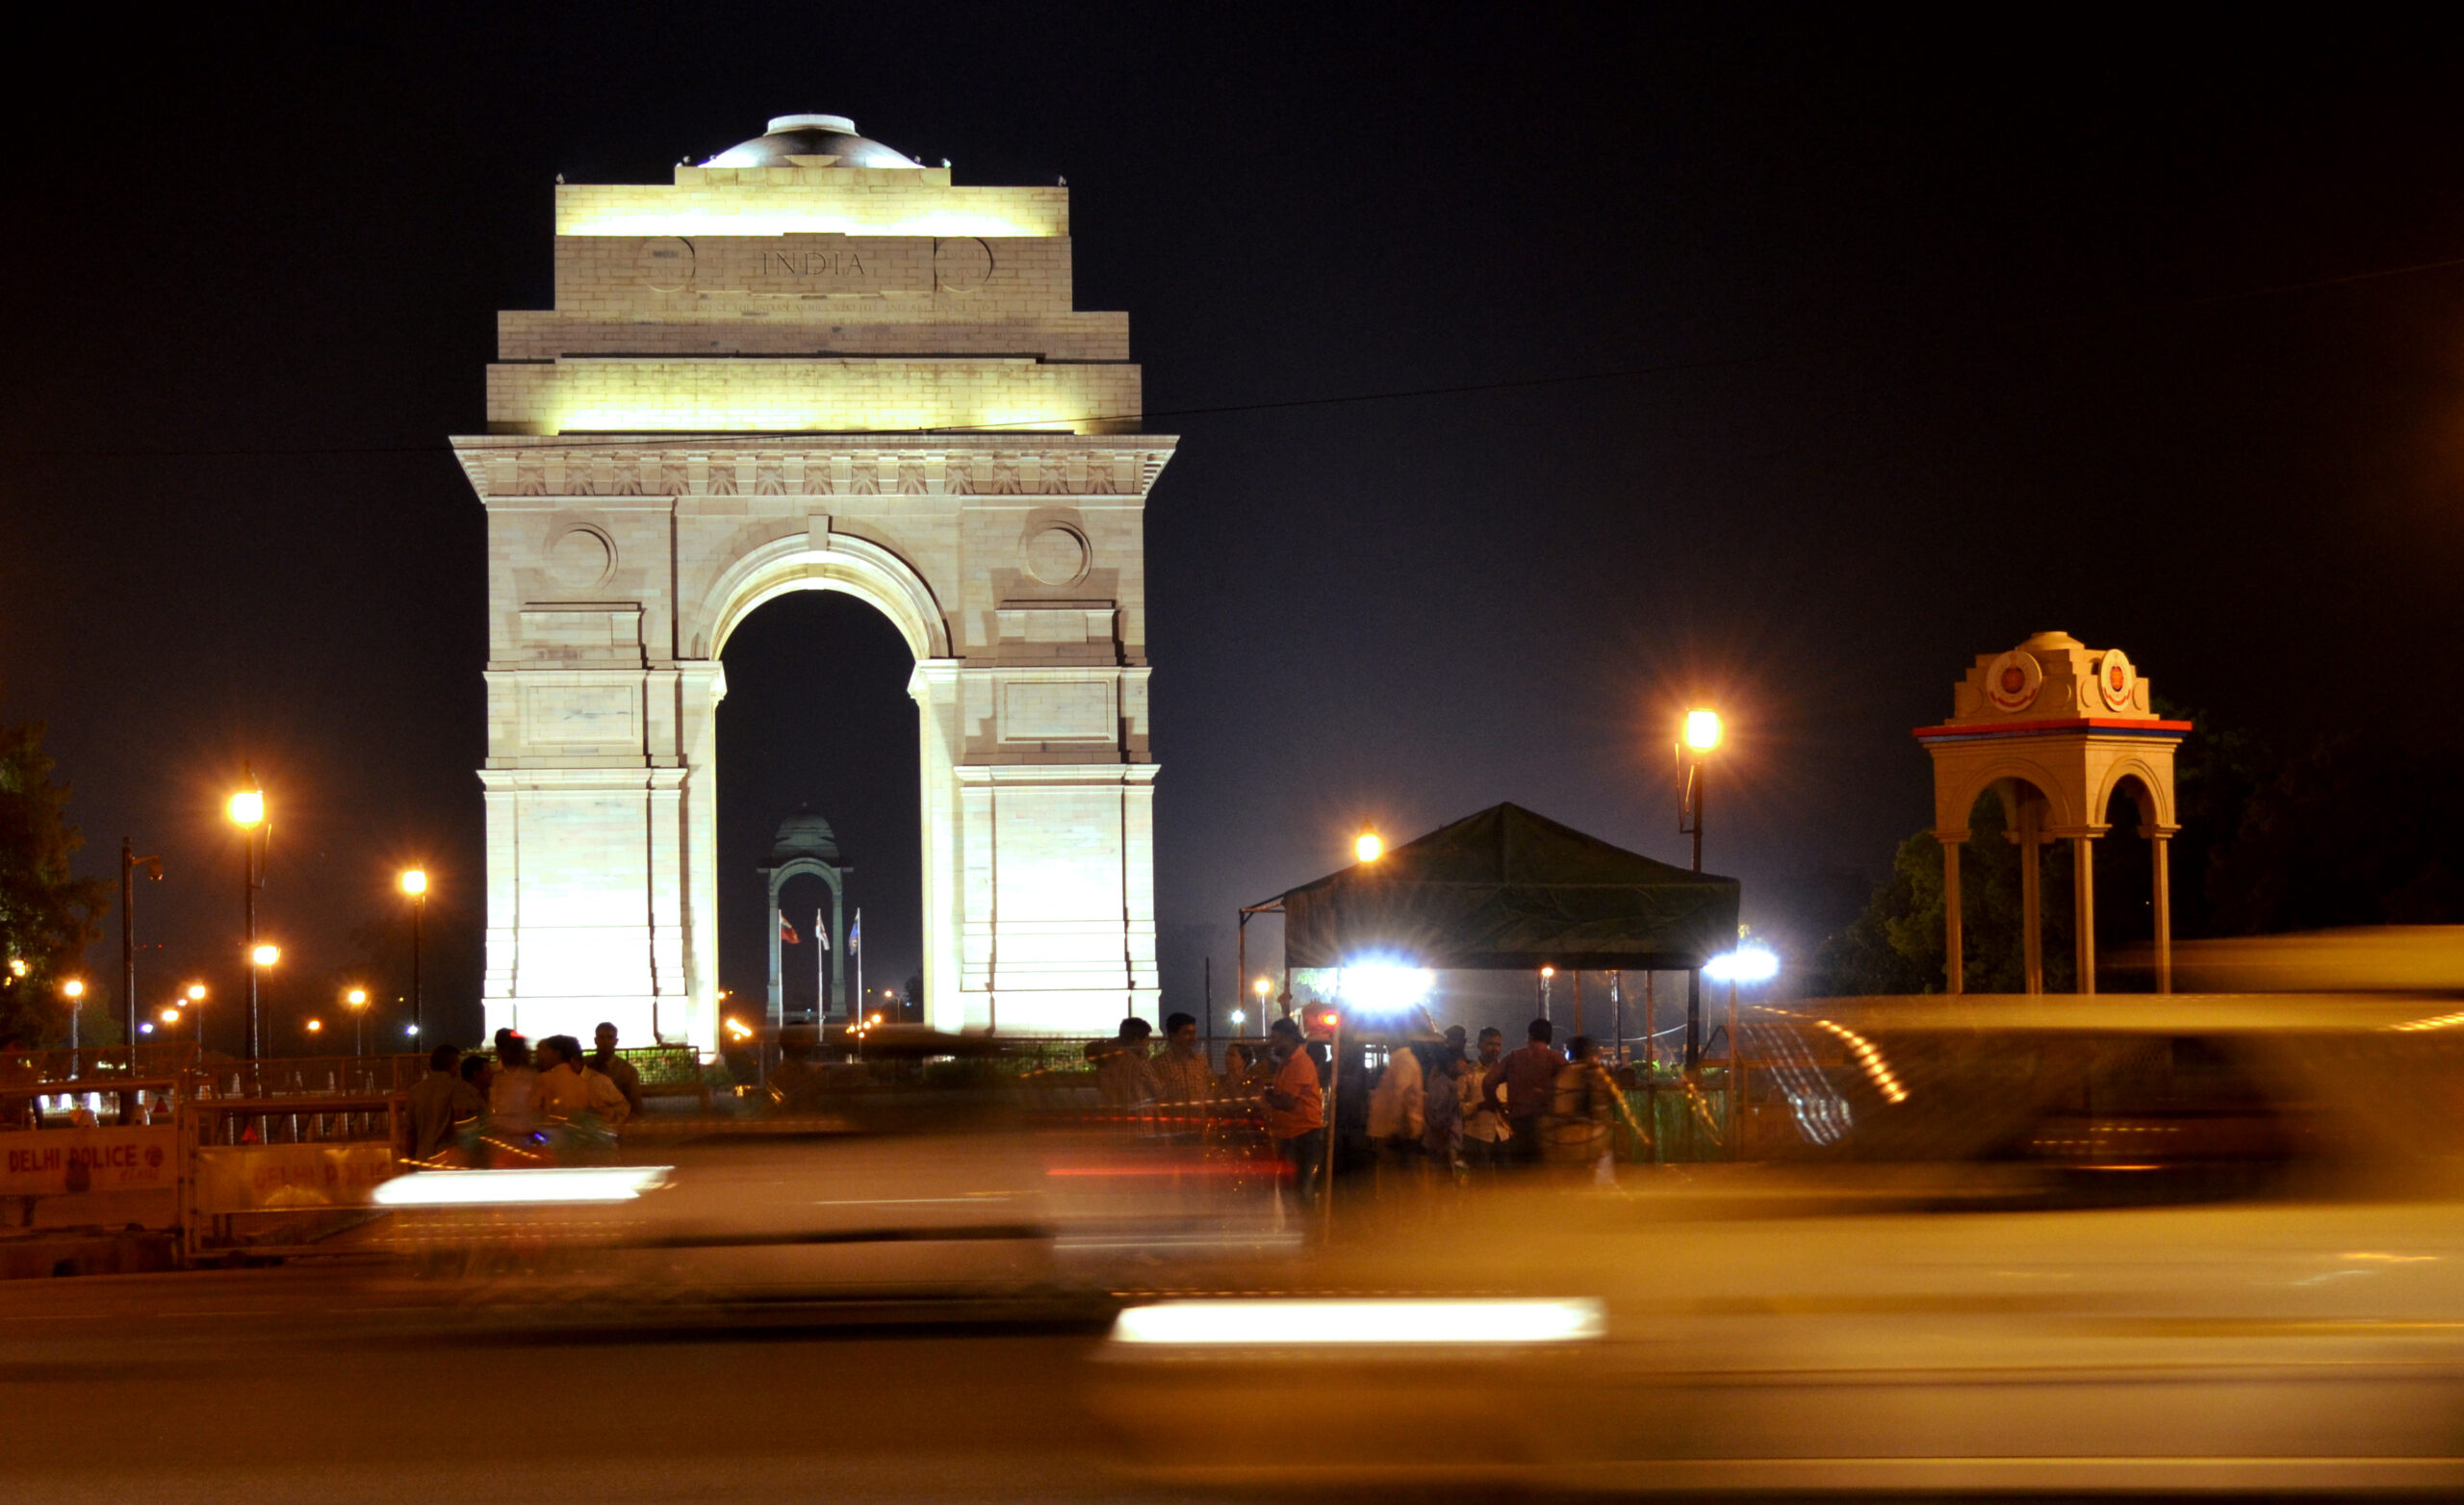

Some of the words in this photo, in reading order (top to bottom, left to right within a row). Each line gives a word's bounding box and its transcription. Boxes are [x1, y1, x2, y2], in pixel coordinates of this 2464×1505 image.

[763, 252, 864, 275] INDIA
[9, 1149, 61, 1172] DELHI
[69, 1144, 138, 1170] POLICE
